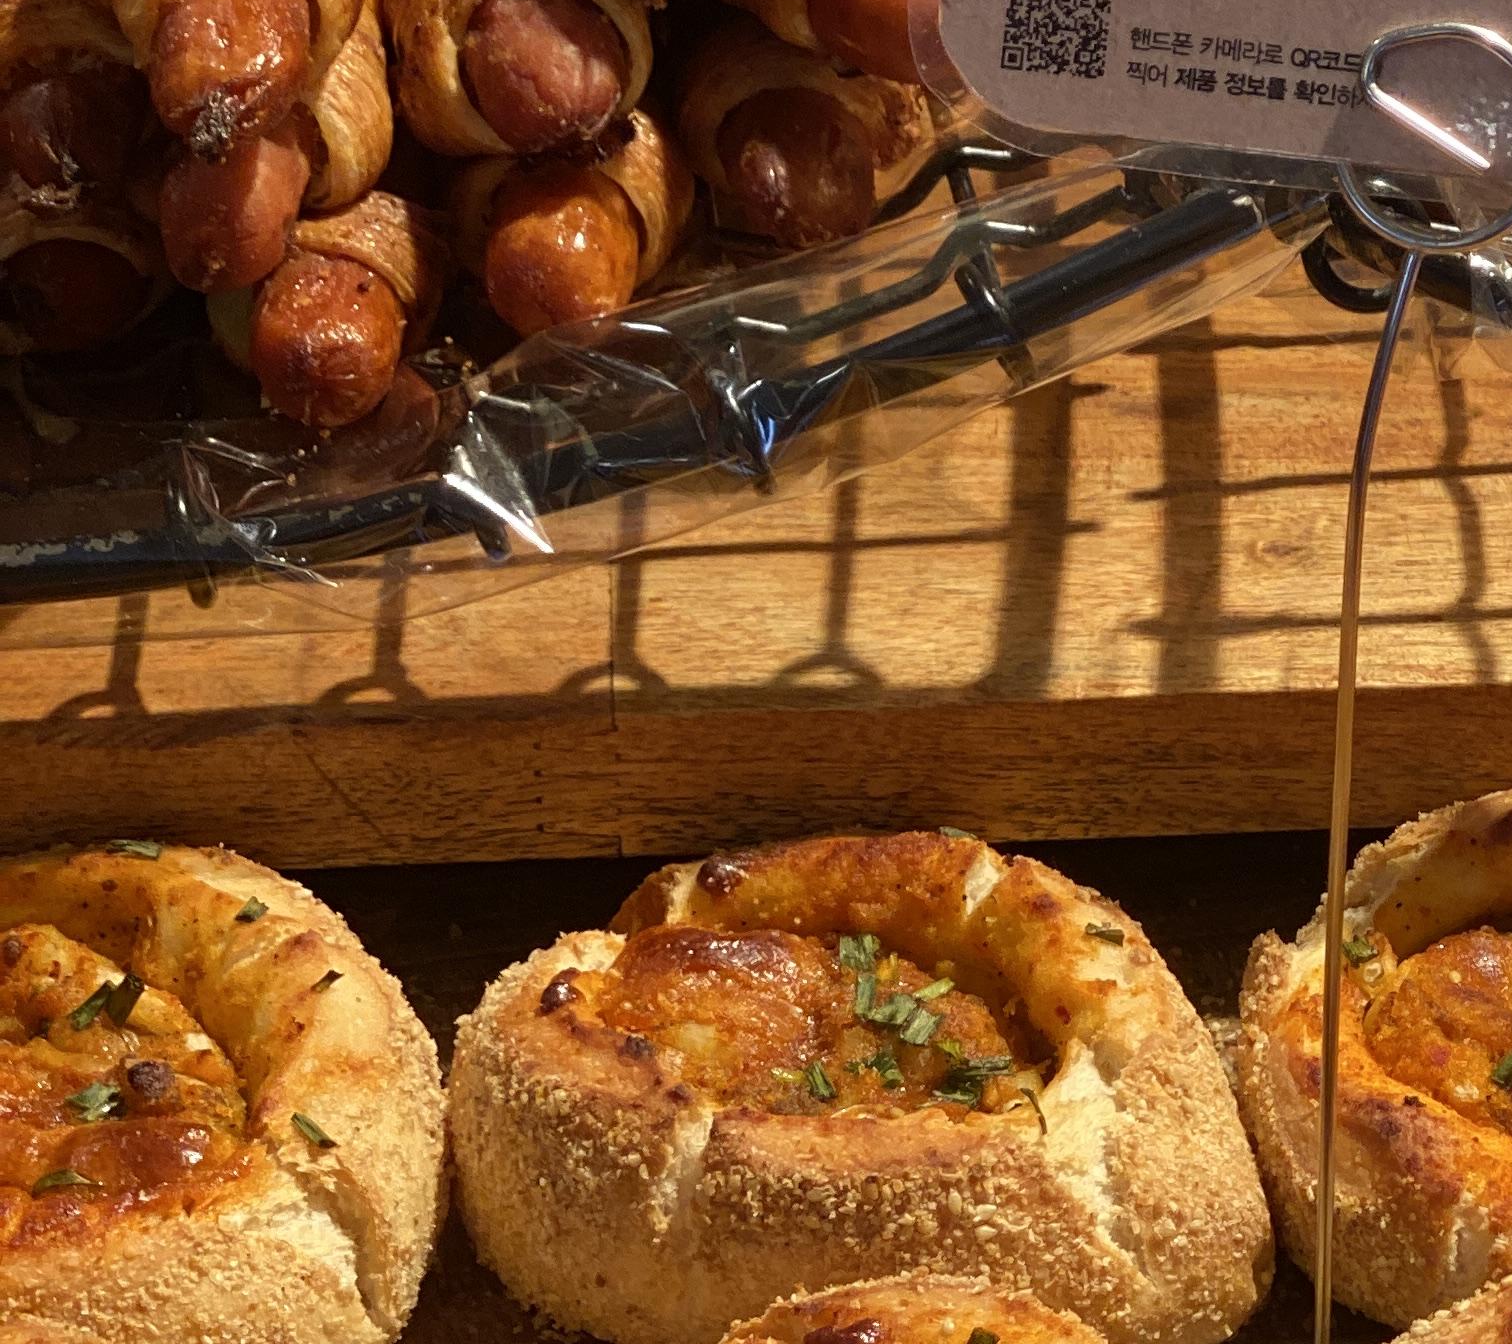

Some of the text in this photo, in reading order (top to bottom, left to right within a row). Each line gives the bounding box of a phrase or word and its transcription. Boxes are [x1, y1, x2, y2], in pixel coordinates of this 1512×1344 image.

[1130, 27, 1370, 76] 핸드폰 카메라로 QR코드
[1126, 60, 1168, 87] 찍어
[1174, 66, 1218, 94] 제품
[1223, 71, 1288, 101] 정보를
